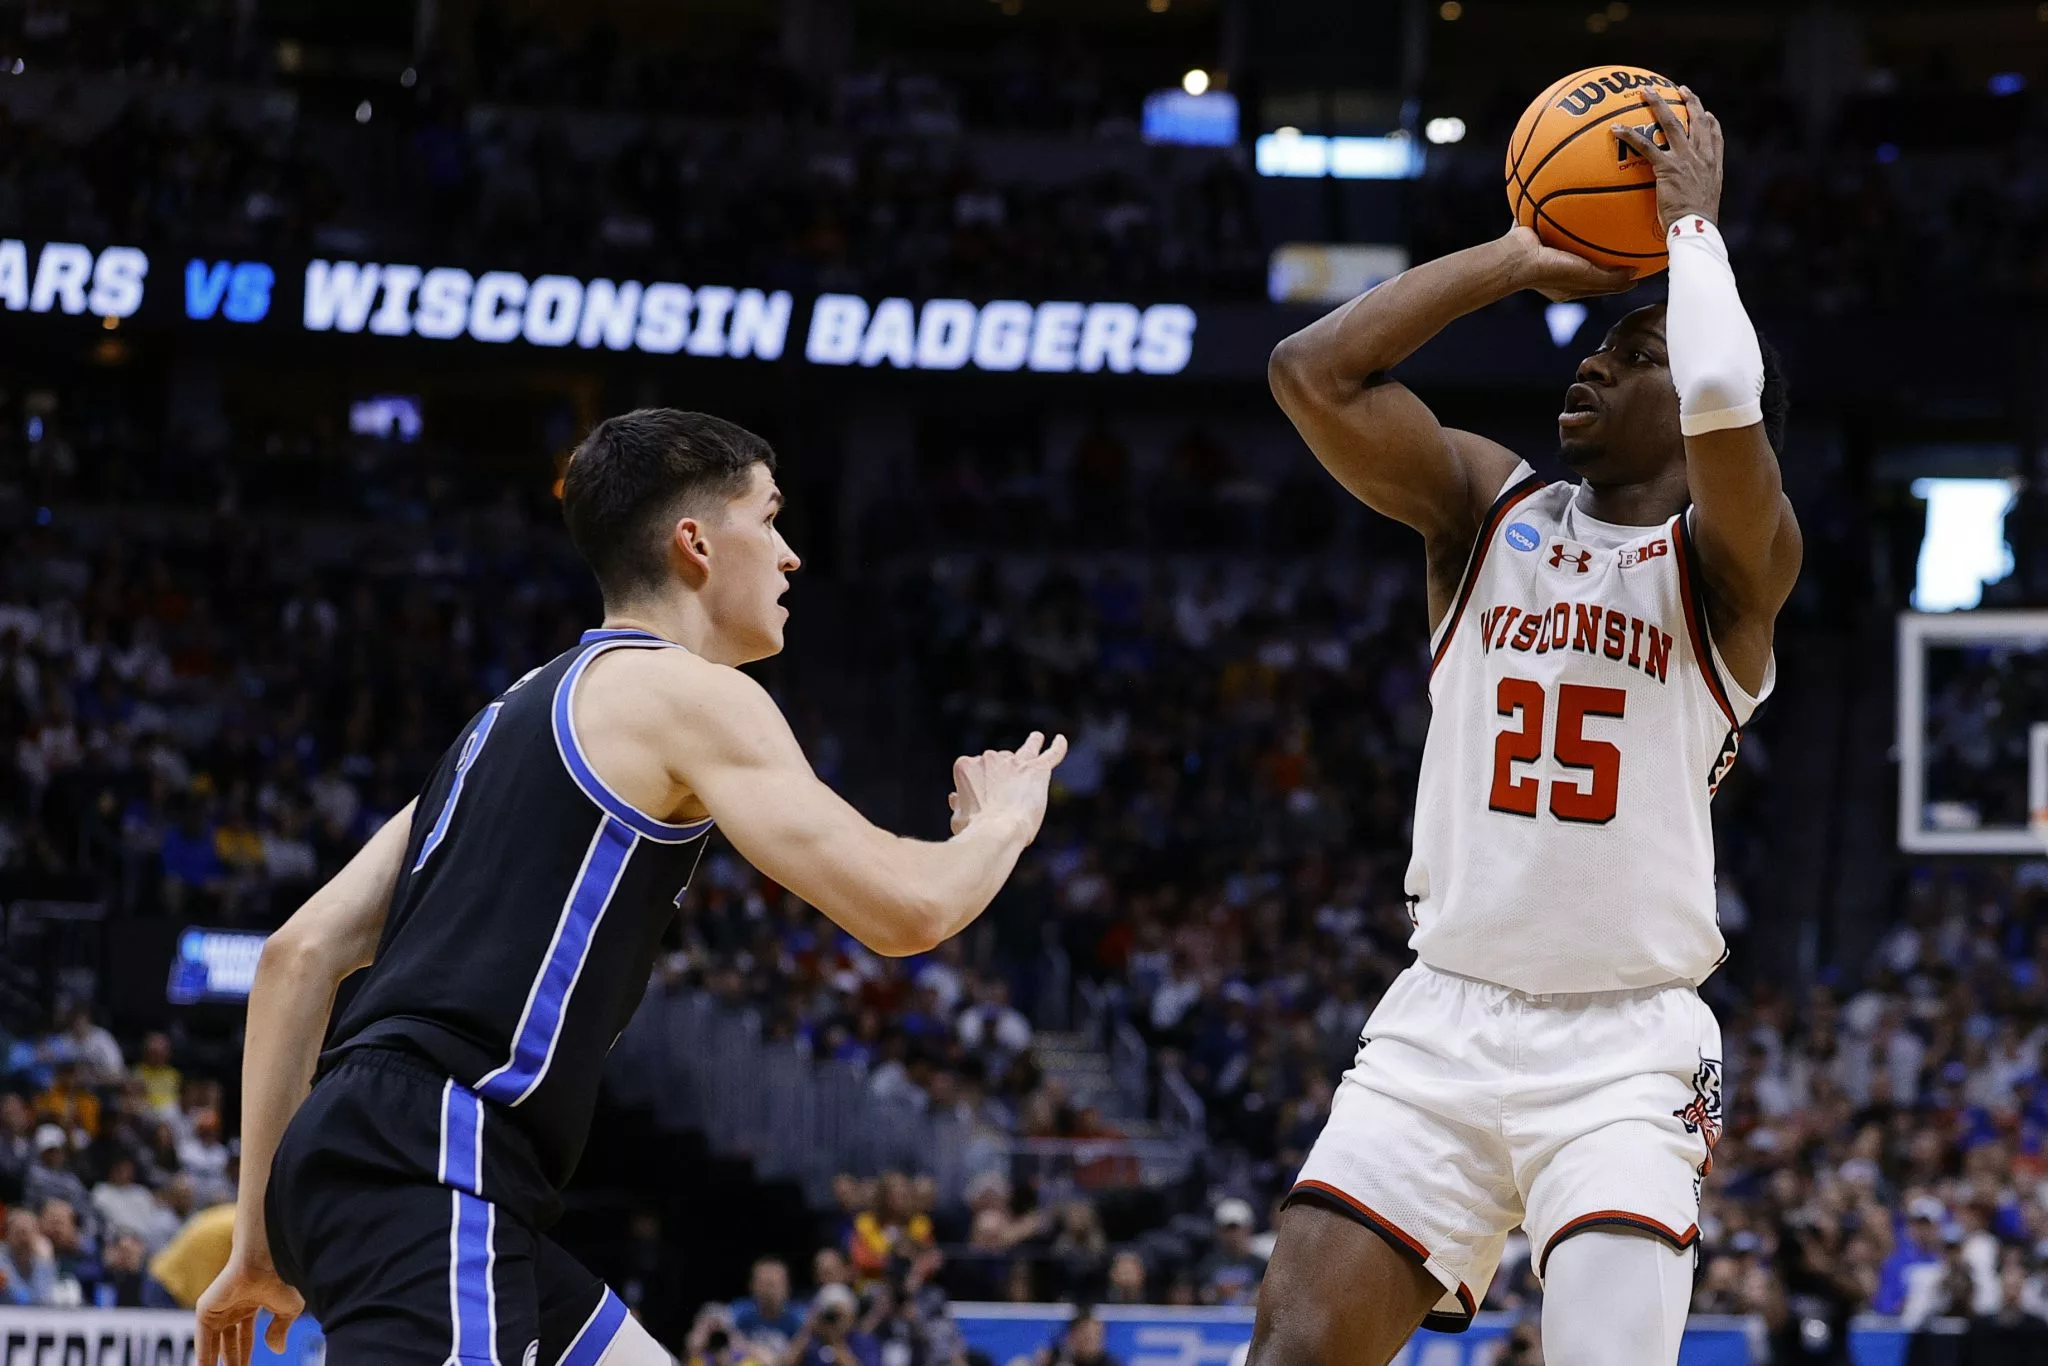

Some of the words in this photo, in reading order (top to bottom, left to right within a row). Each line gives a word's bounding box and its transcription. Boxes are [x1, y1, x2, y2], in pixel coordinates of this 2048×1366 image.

[185, 257, 275, 323] VS
[303, 258, 793, 361] WISCONSIN
[805, 293, 1197, 375] BADGERS
[1508, 528, 1535, 551] NCAA
[1480, 602, 1673, 685] WISCONSIN
[1489, 677, 1626, 826] 25
